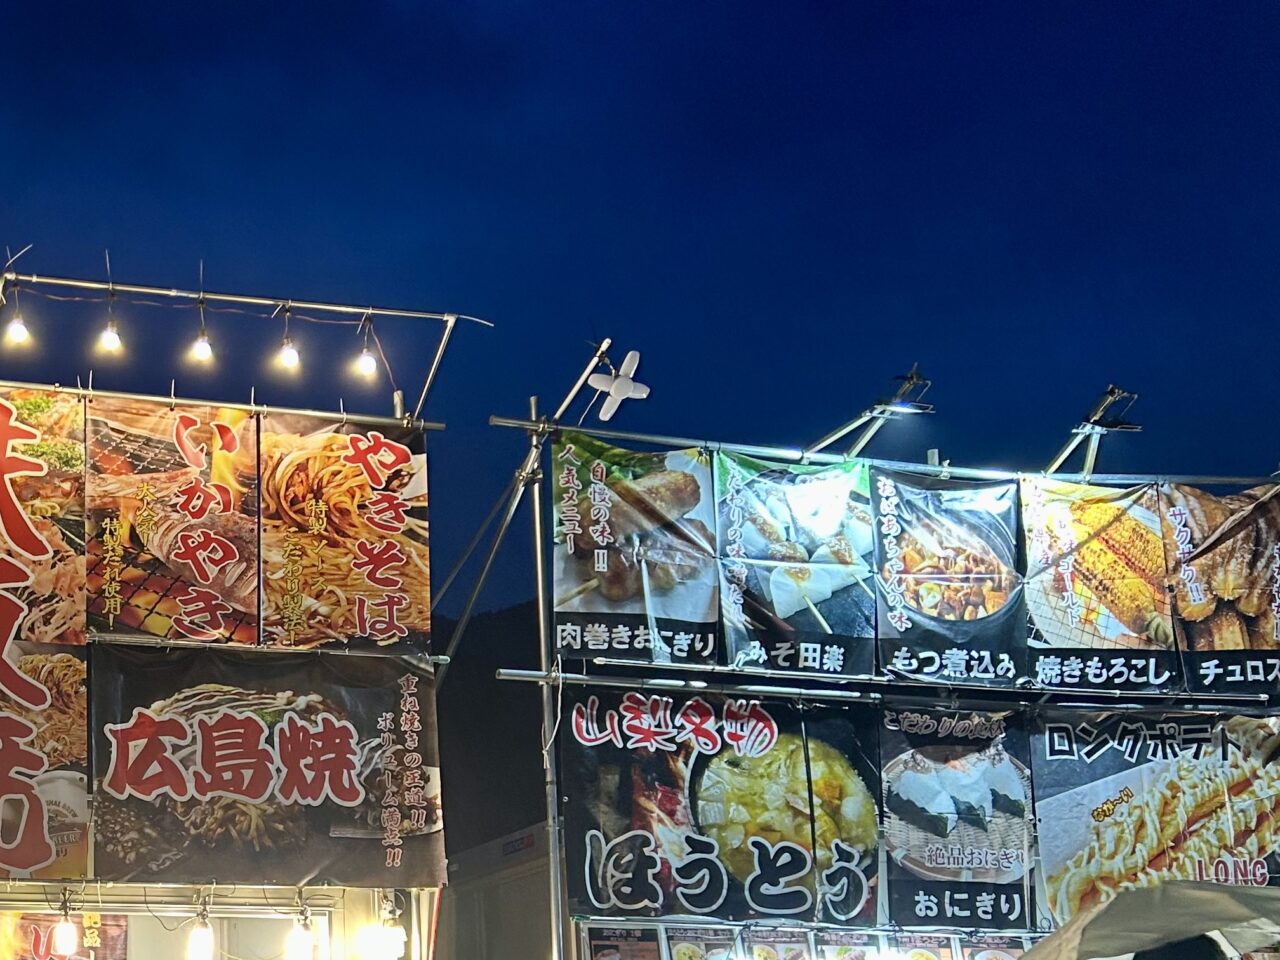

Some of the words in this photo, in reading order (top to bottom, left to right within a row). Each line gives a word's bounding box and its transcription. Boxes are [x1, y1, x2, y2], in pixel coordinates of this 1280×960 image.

[136, 482, 158, 551] 大人気!
[172, 413, 239, 640] いかやき
[341, 431, 412, 638] やきそば
[558, 443, 582, 555] 人気メニュー
[588, 459, 614, 572] 自慢の味!!
[306, 500, 329, 591] 特製ソース
[877, 476, 912, 632] おばあちゃんの味
[1169, 506, 1204, 605] サクサク!!
[282, 527, 305, 645] こだわり製法!
[556, 622, 715, 657] 肉巻きおにぎり
[731, 640, 845, 672] みそ田楽
[891, 646, 1016, 679] もつ煮込み
[1036, 655, 1169, 685] 焼きもろこし
[1199, 658, 1280, 686] チュロス
[102, 707, 366, 807] 広島焼
[572, 692, 778, 757] 山梨名物
[1045, 722, 1241, 763] ロングポテト
[585, 829, 869, 920] ほうとう
[925, 845, 1026, 869] 絶品おにぎり
[914, 891, 1022, 921] おにぎり
